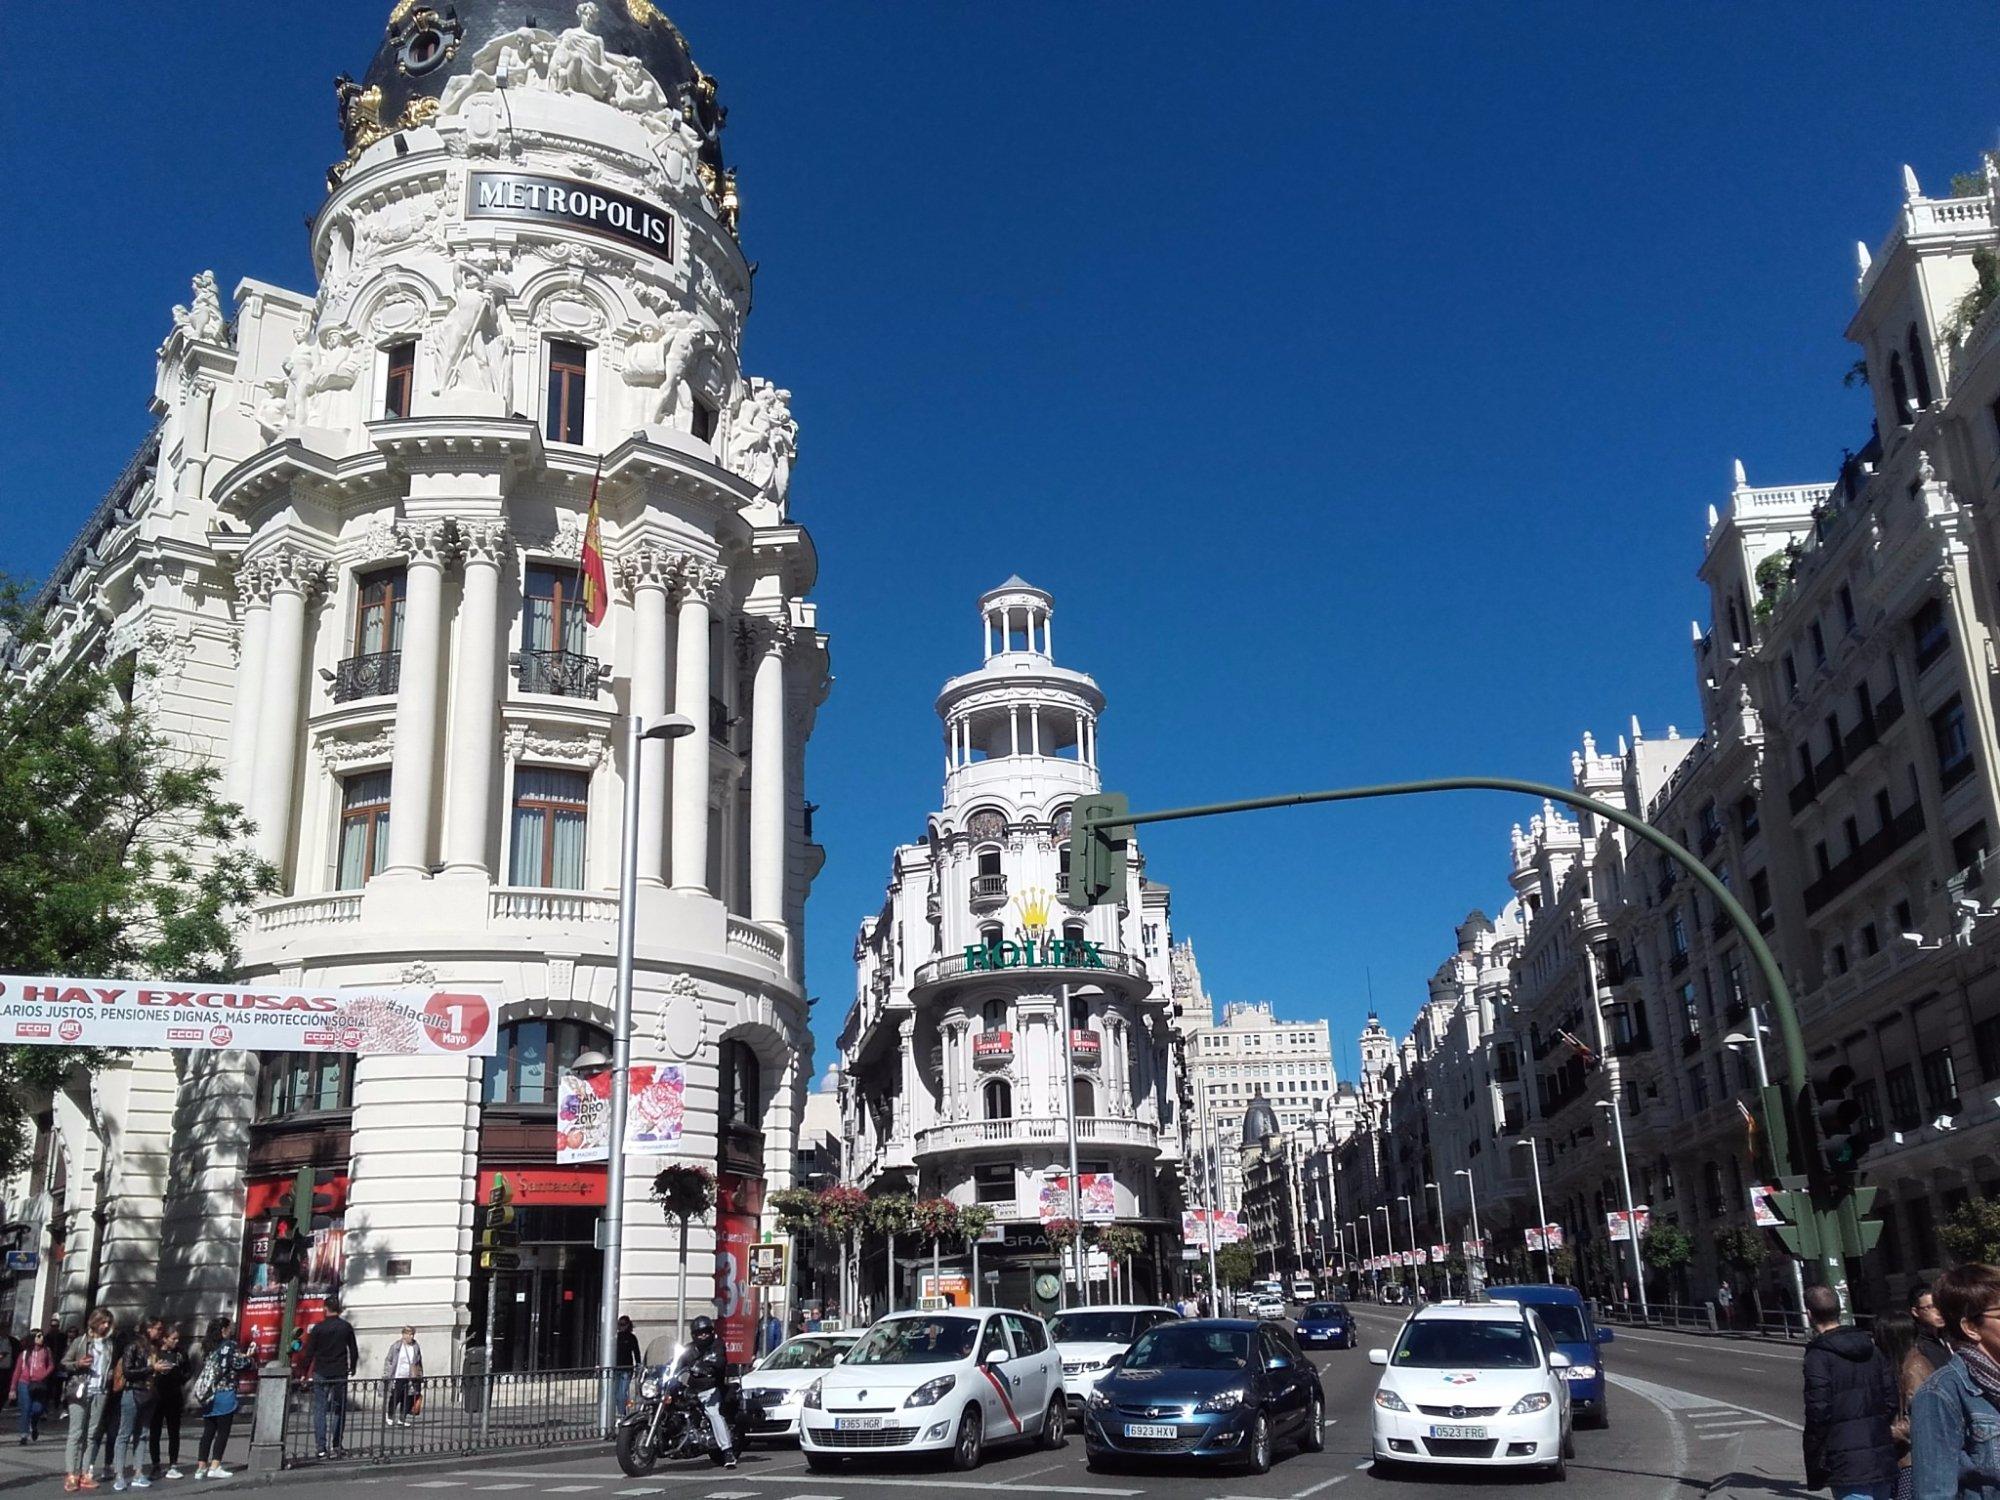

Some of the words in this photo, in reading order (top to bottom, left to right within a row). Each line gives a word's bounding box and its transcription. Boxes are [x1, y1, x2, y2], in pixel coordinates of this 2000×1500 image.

[478, 180, 666, 244] METROPOLIS
[963, 938, 1107, 972] ROLEX
[22, 985, 127, 1005] HAY
[137, 990, 338, 1012] EXCUSAS
[0, 1004, 43, 1017] ARIOS
[46, 1006, 97, 1020] JUSTOS,
[101, 1008, 169, 1021] PENSIONES
[173, 1010, 222, 1024] DIGNAS,
[226, 1010, 250, 1024] MÁS
[254, 1012, 328, 1026] PROTECCIÓN
[331, 1016, 372, 1028] SOCIAL
[385, 1000, 448, 1031] #alacalle
[446, 1005, 464, 1034] 1
[18, 1024, 50, 1033] CCOO
[61, 1022, 80, 1032] UGT
[212, 1027, 230, 1038] UGT
[169, 1030, 201, 1039] CCOO
[305, 1032, 334, 1041] CCOO
[344, 1030, 361, 1040] UGT
[443, 1033, 467, 1045] Mayo
[574, 1113, 598, 1125] 2017
[1003, 1235, 1049, 1246] GRA
[840, 1418, 861, 1429] 9365
[863, 1418, 880, 1428] HGR
[1131, 1425, 1155, 1436] 6923
[1156, 1426, 1175, 1437] HXV
[1436, 1427, 1461, 1438] 0523
[1465, 1427, 1485, 1438] FRG
